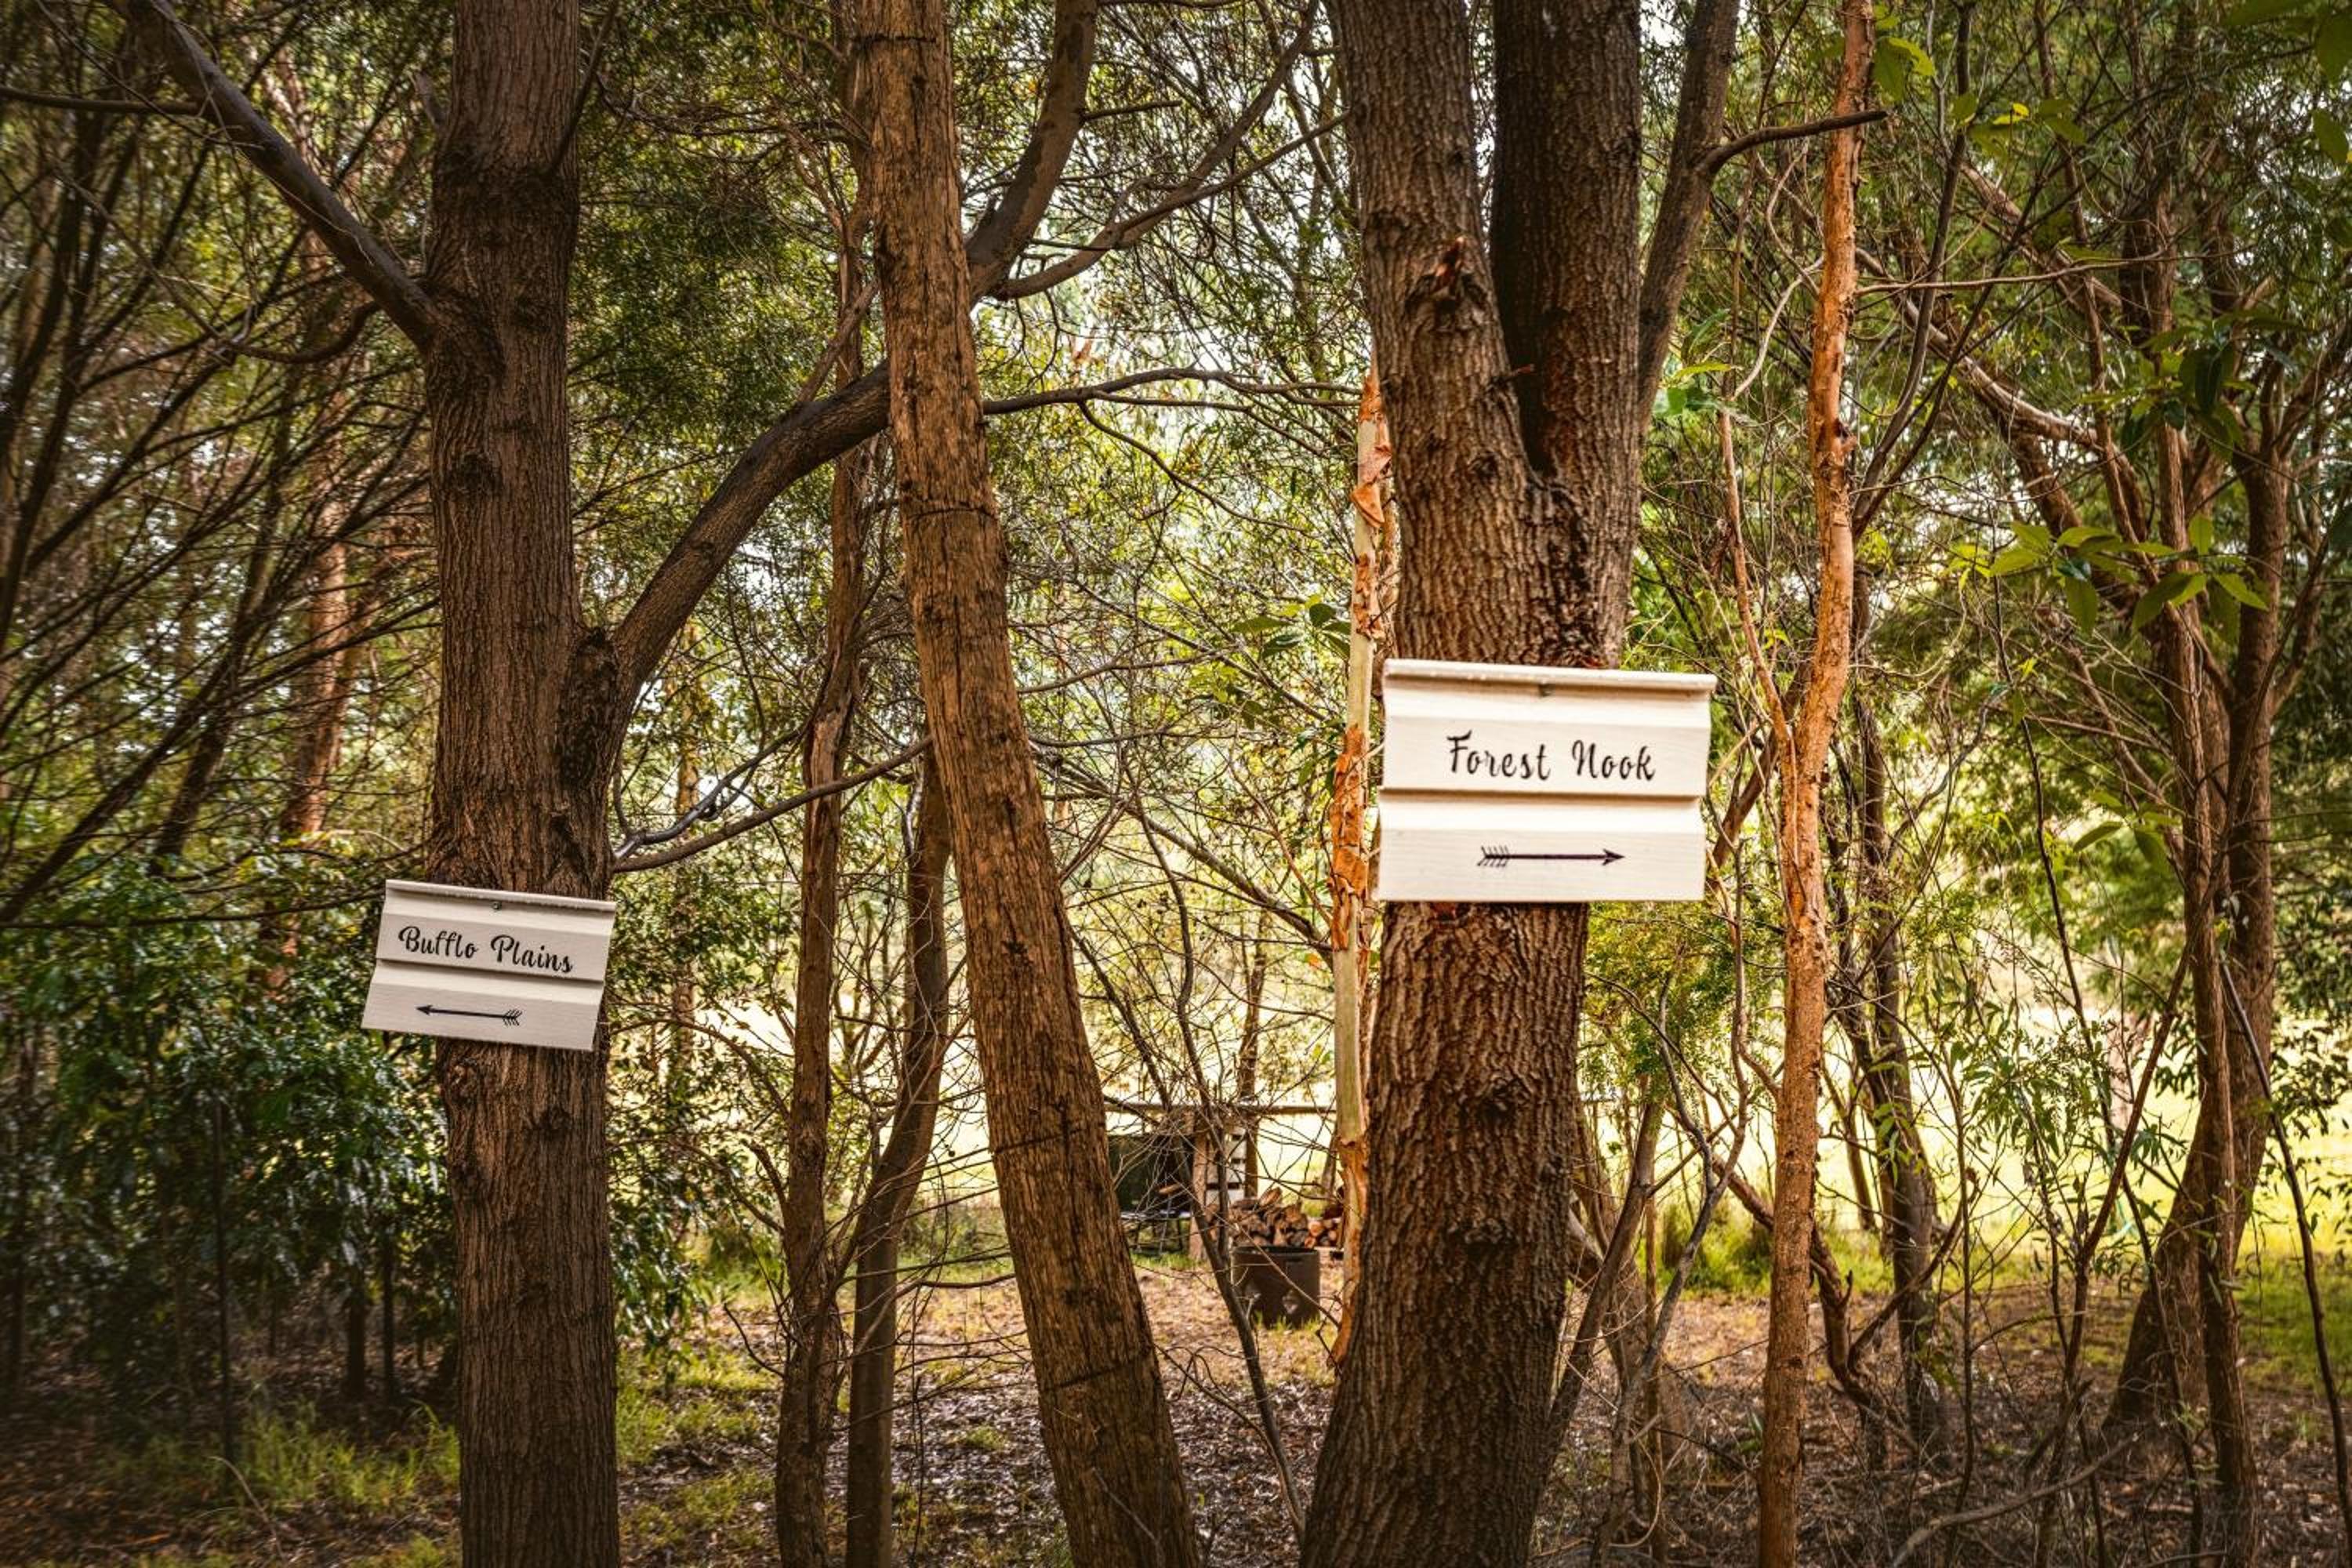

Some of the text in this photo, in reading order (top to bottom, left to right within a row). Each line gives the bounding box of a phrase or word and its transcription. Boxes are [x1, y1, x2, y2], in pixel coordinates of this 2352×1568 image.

[1446, 729, 1656, 781] Forest Nook
[398, 926, 573, 973] Bufflo Plains
